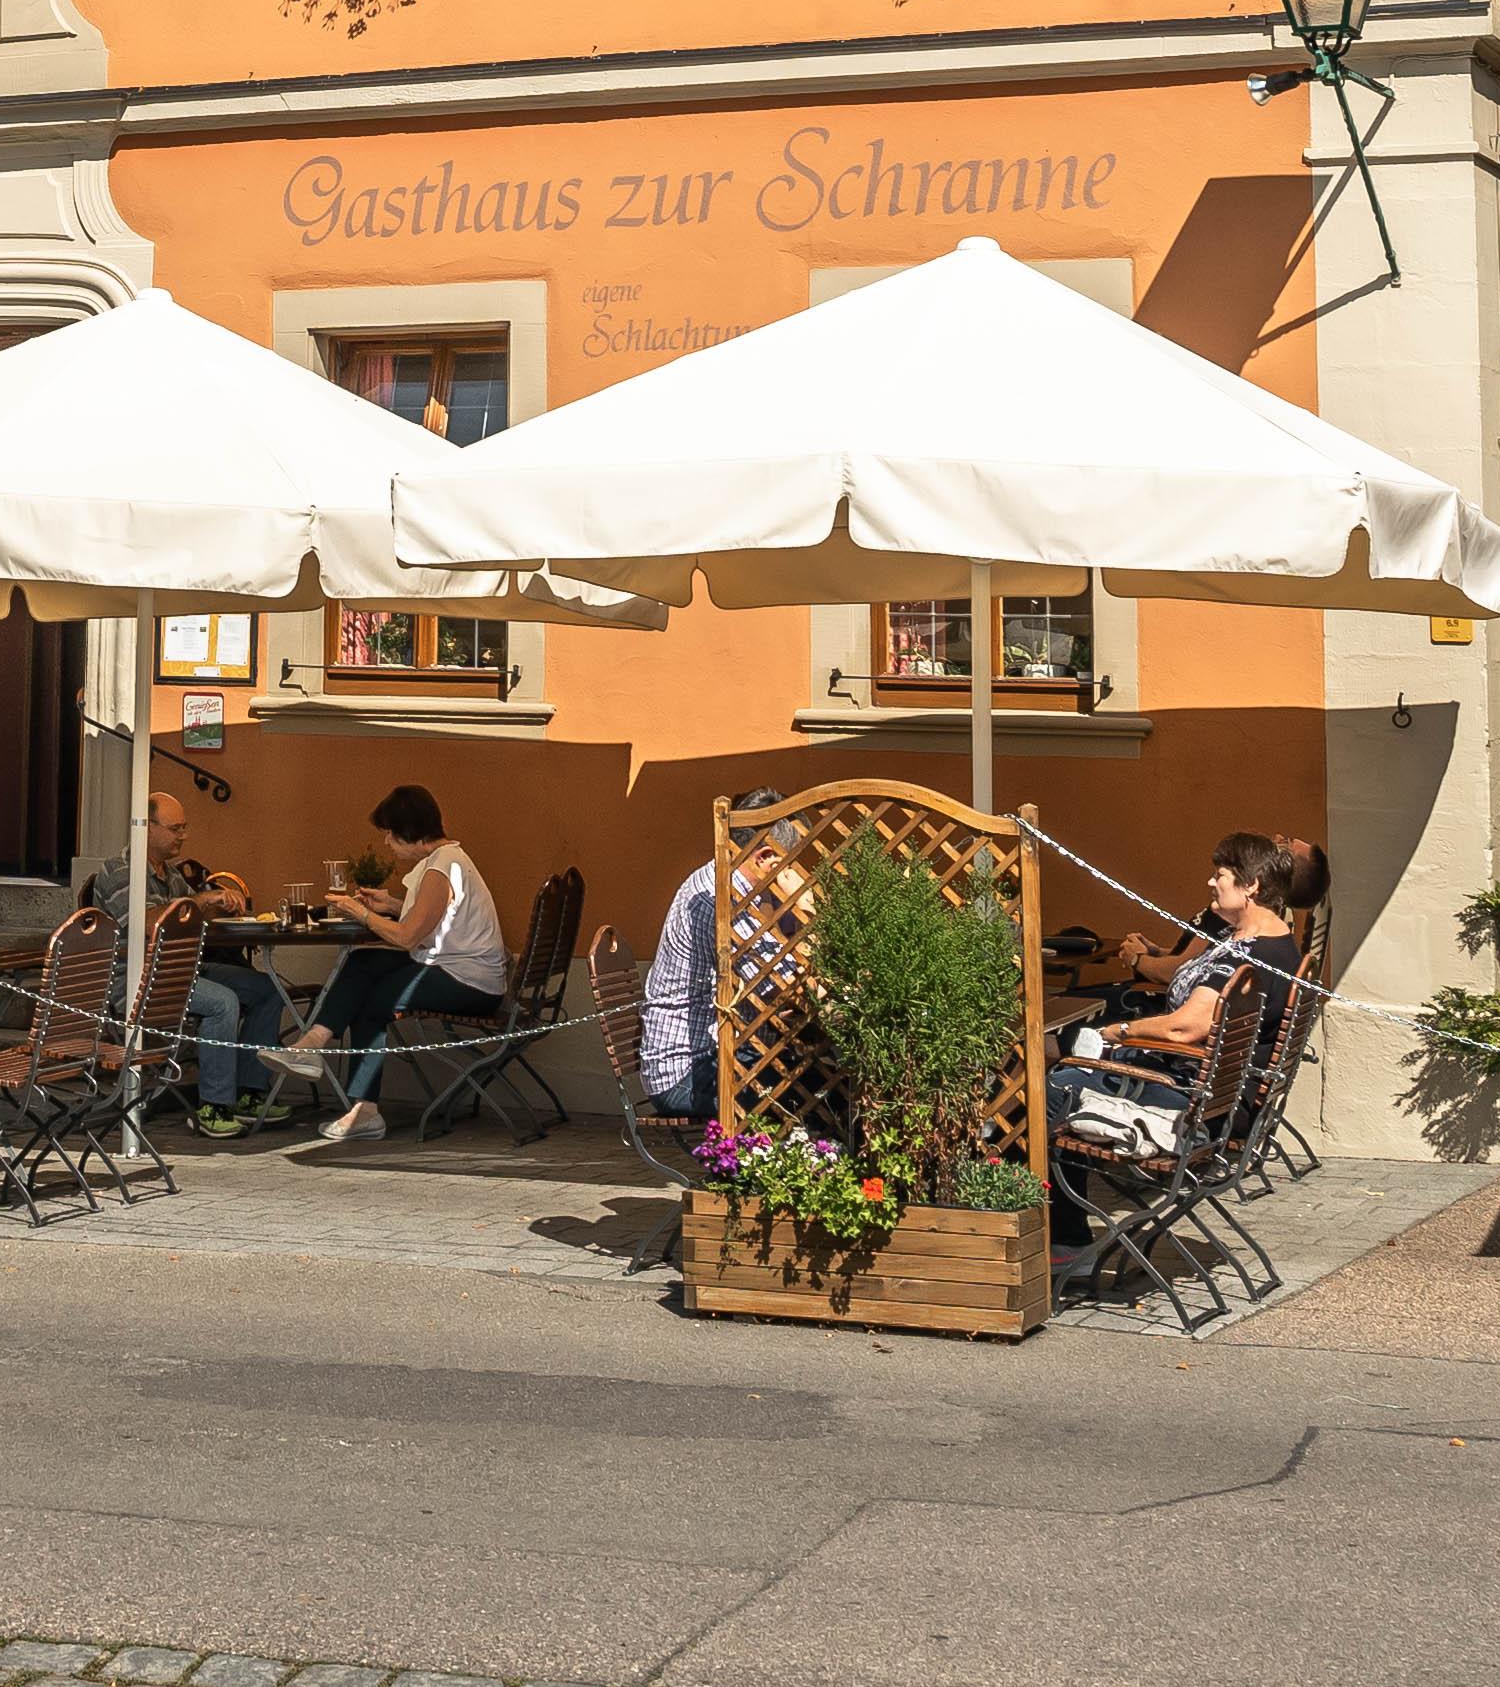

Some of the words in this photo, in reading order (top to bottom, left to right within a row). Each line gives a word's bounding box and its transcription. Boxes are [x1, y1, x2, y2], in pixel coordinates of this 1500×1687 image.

[283, 155, 581, 247] Gasthaus
[605, 169, 734, 229] zur
[755, 126, 1117, 232] Schranne
[582, 280, 642, 314] eigene
